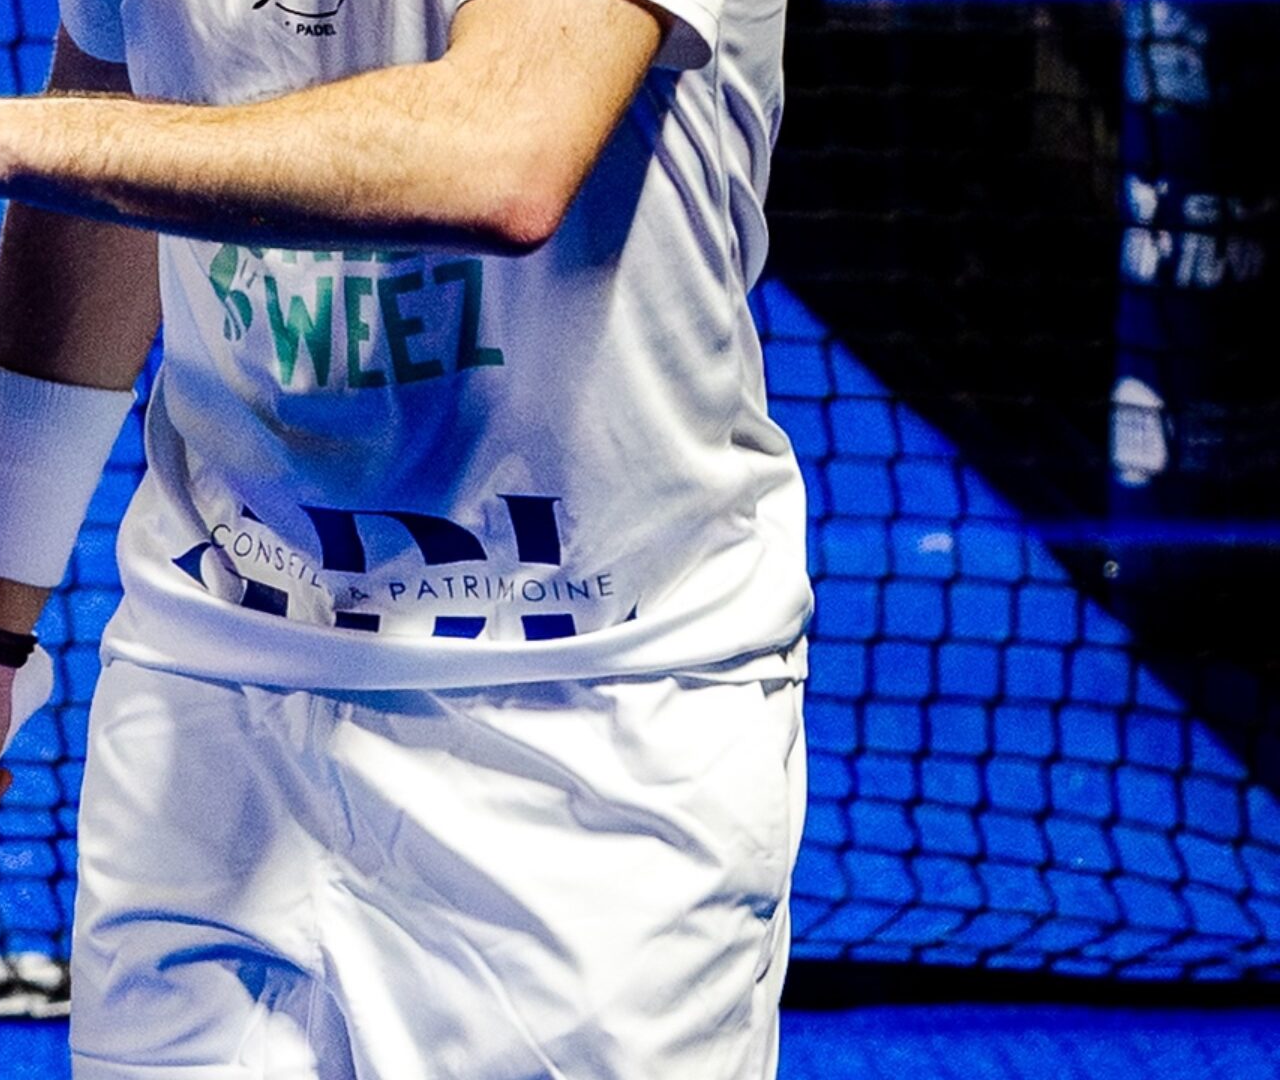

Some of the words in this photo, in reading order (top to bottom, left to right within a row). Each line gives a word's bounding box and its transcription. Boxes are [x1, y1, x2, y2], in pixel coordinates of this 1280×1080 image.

[264, 258, 505, 389] WEEZ
[209, 523, 324, 589] CONSEIL
[390, 572, 616, 604] PATRIMOINE
